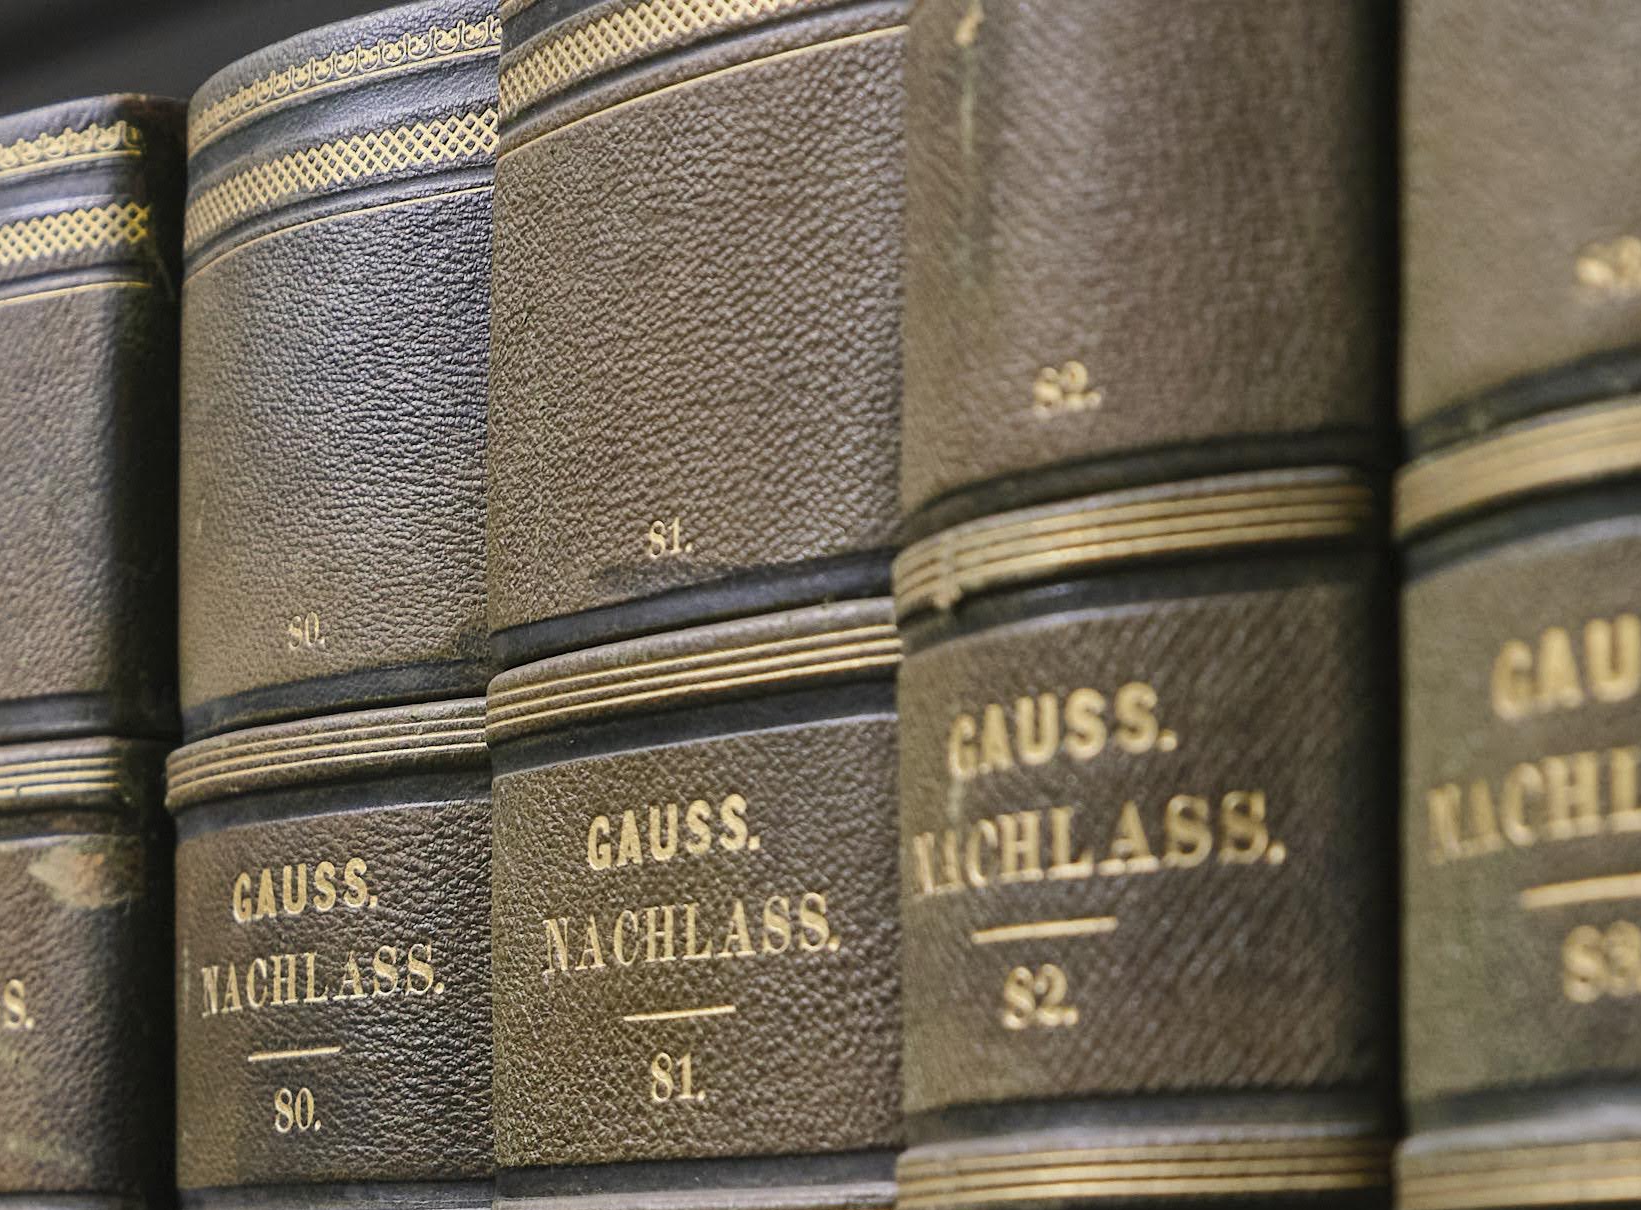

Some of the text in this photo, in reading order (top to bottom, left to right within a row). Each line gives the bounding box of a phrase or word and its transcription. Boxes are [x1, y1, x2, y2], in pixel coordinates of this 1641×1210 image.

[1031, 358, 1103, 421] 82.
[646, 516, 694, 559] 81.
[287, 611, 327, 650] 80.
[946, 680, 1178, 784] GAUSS.
[586, 793, 762, 871] GAUSS.
[910, 788, 1288, 899] NACHLASS.
[232, 857, 379, 924] GAUSS.
[542, 892, 842, 977] NACHLASS.
[201, 943, 446, 1018] NACHLASS.
[1000, 961, 1080, 1031] 82.
[274, 1086, 322, 1133] 80.
[649, 1051, 707, 1102] 81.
